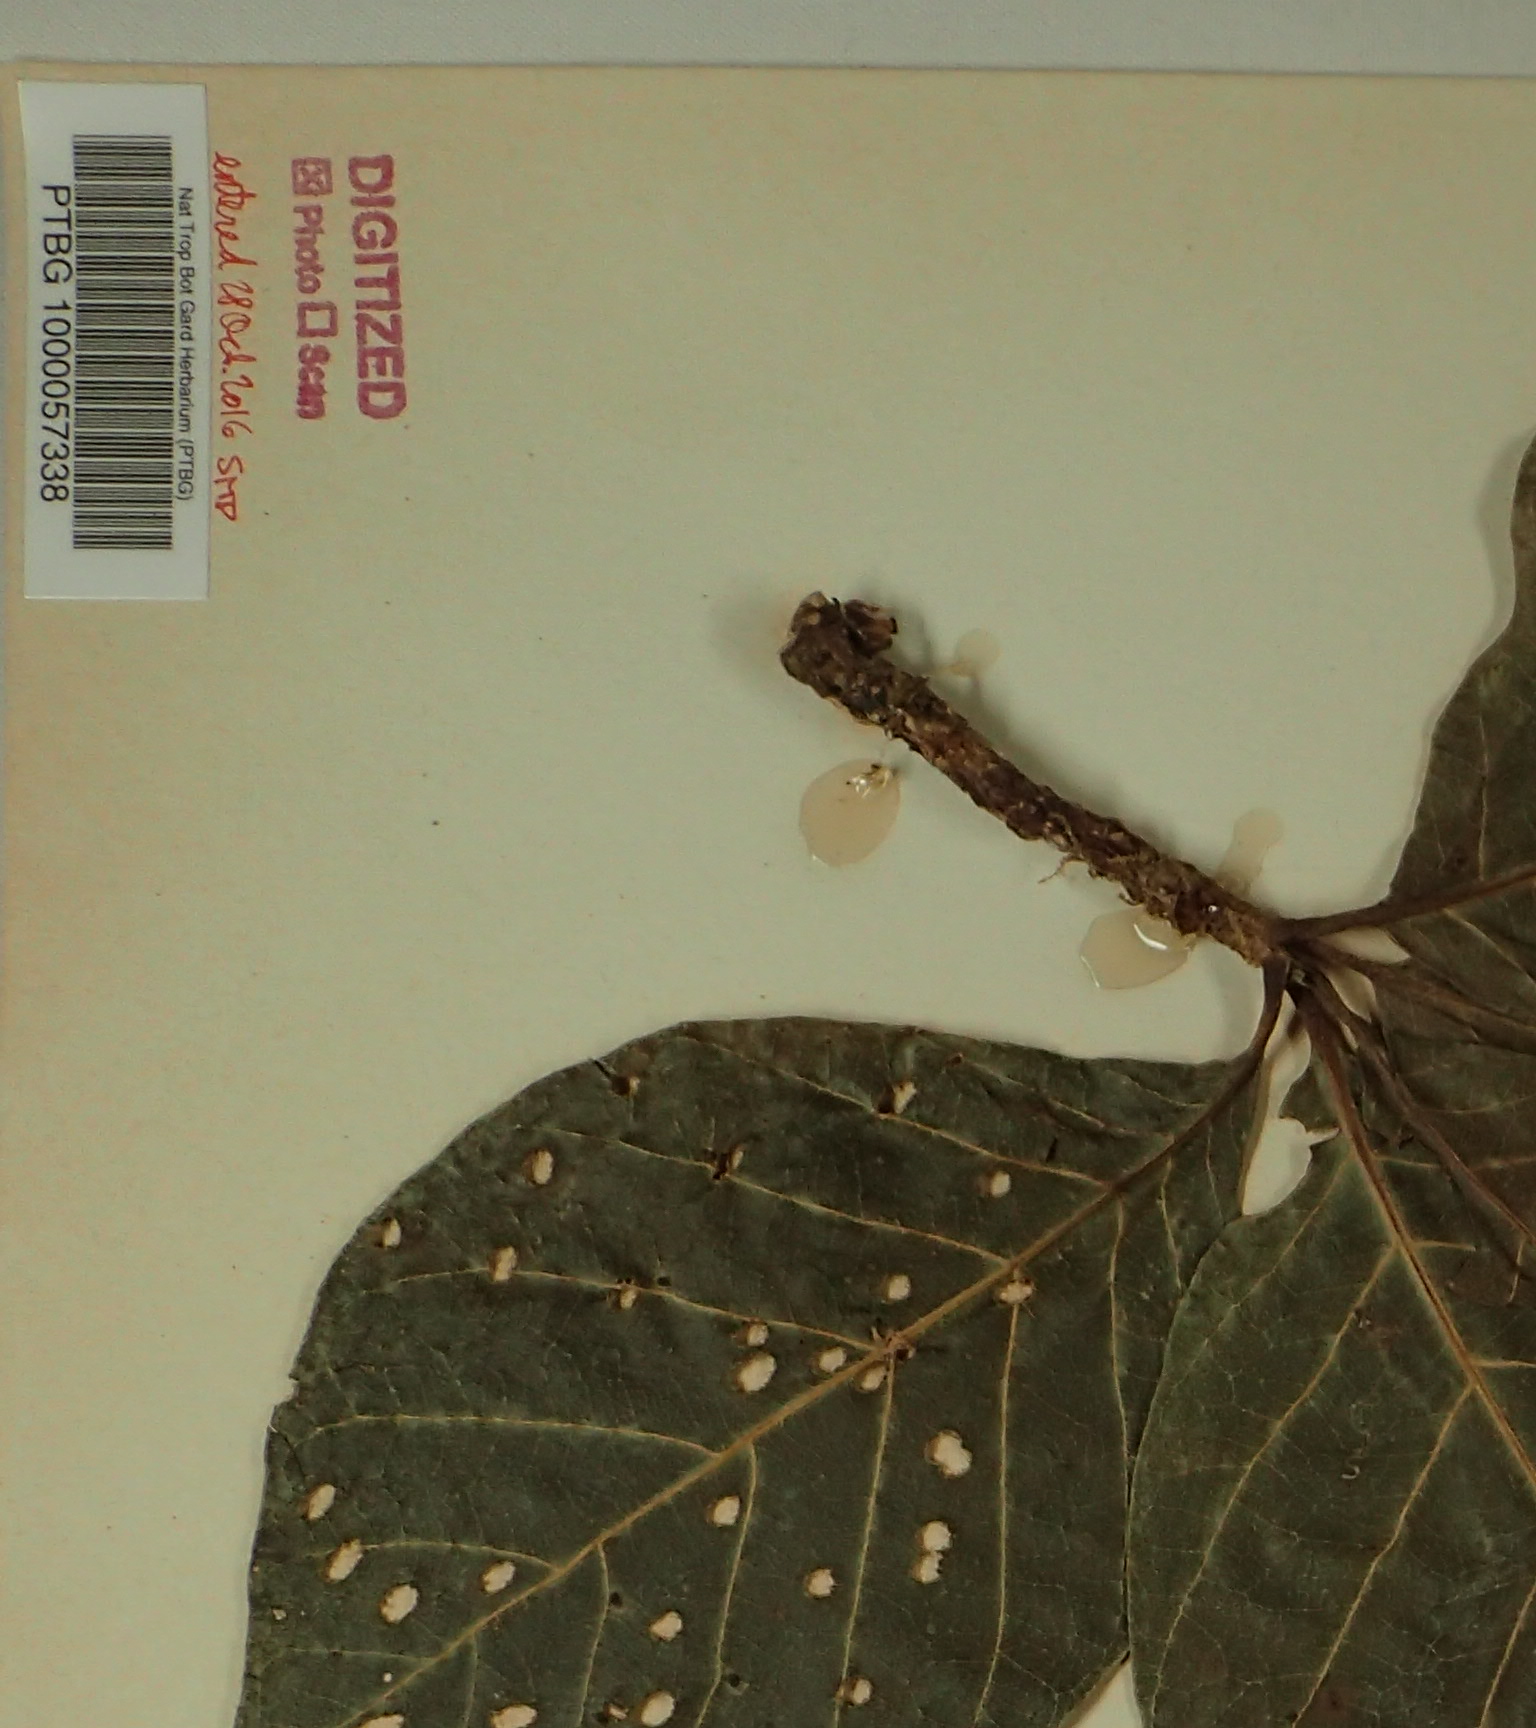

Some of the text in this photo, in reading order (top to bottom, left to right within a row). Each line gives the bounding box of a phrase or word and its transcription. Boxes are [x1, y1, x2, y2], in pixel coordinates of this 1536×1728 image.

[213, 151, 258, 270] entered
[293, 205, 334, 420] Photo Scan
[348, 155, 407, 420] DIGITIZED
[40, 186, 73, 502] PTBG 1000057338
[173, 188, 195, 500] Nat Trop Bot Gard Herbarium (PTBG)
[220, 374, 255, 438] 2016
